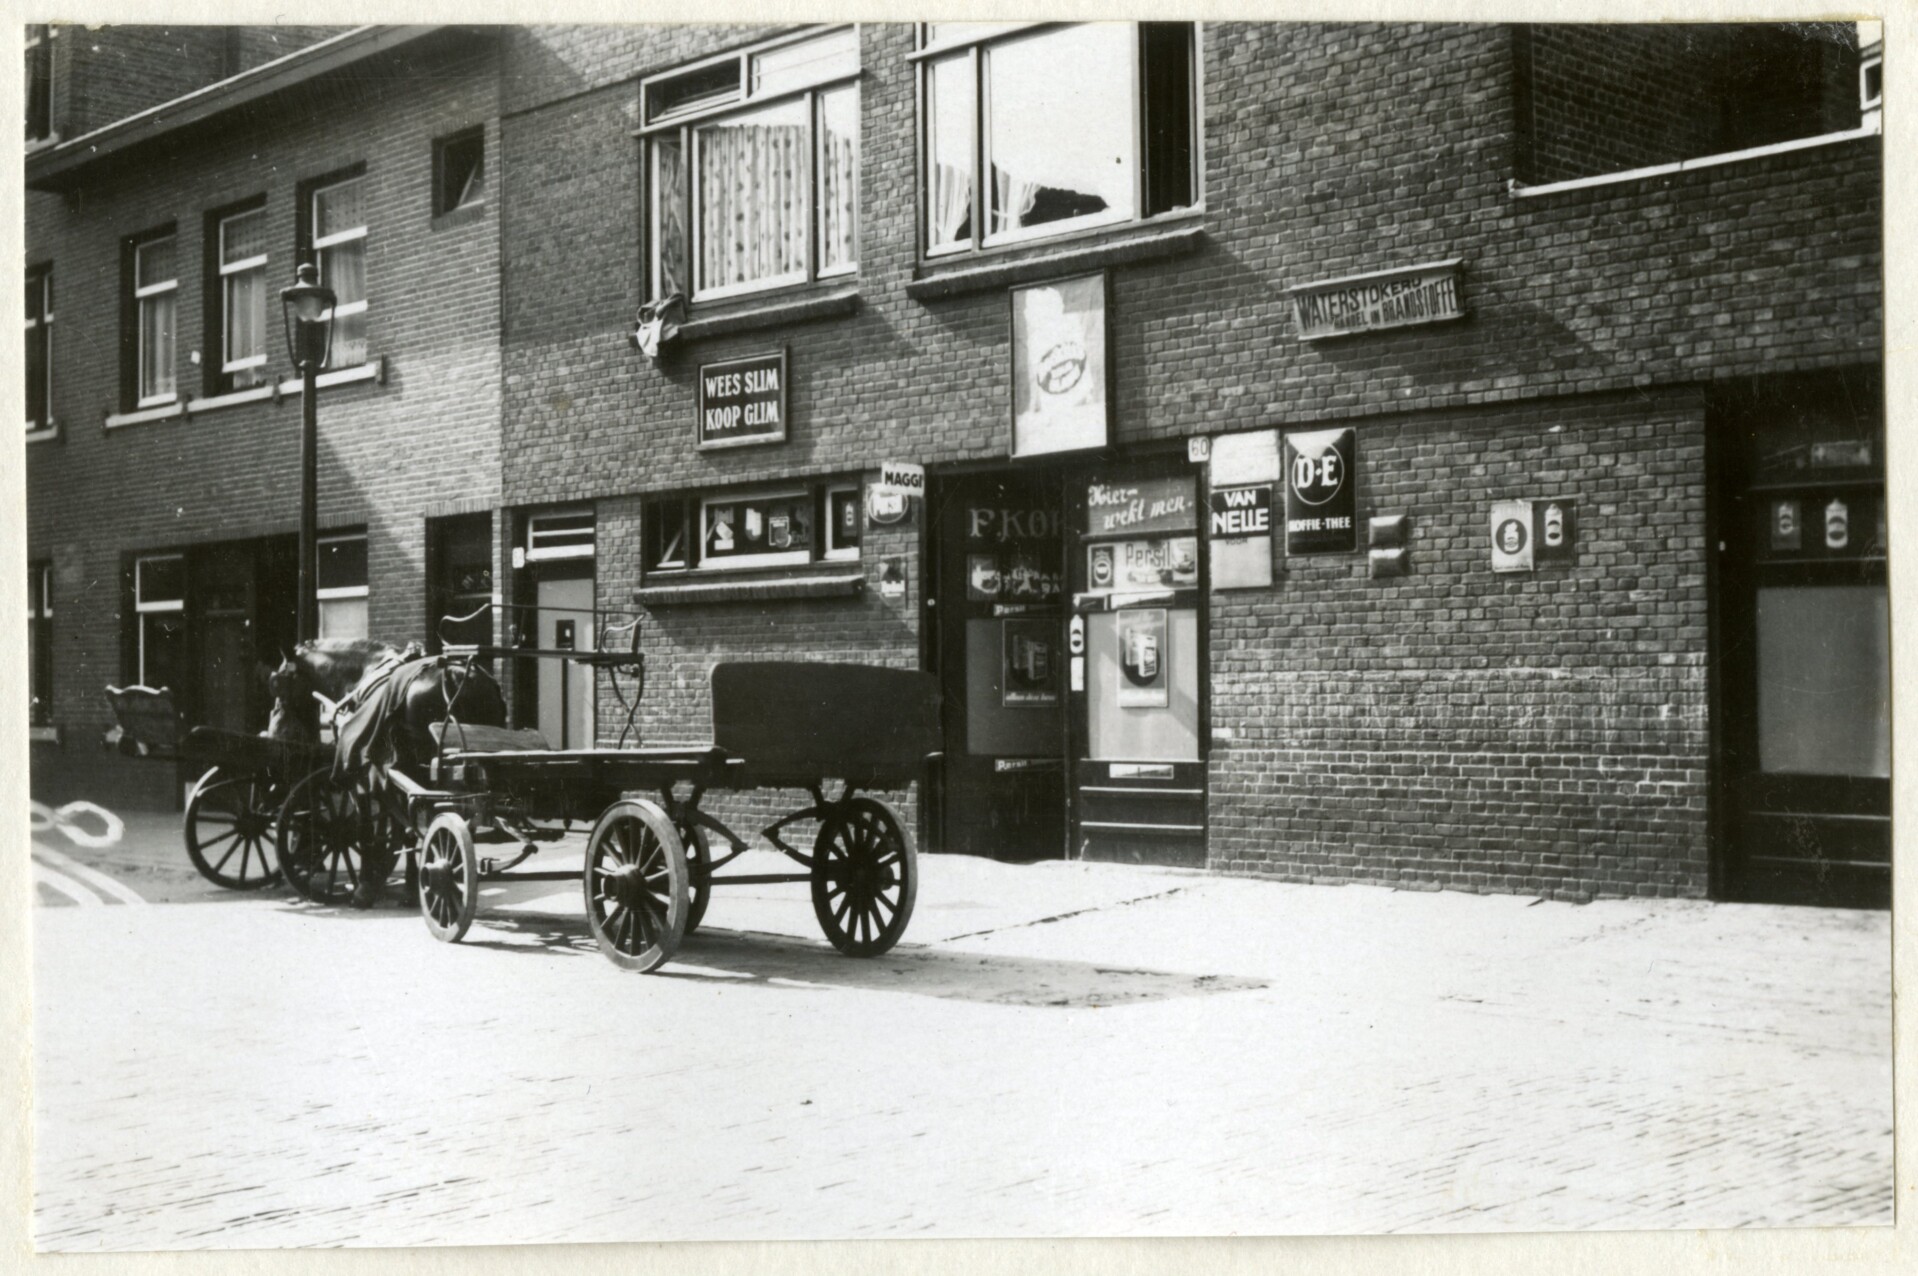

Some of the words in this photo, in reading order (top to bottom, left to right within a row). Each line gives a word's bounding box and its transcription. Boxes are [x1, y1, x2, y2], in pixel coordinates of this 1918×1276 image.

[705, 373, 741, 399] WEES
[744, 368, 779, 394] SLIM
[705, 405, 741, 431] KOOP
[744, 401, 779, 425] GLIM
[1191, 438, 1208, 456] 60
[885, 471, 922, 488] MAGGI
[1224, 490, 1257, 508] VAN
[1211, 508, 1269, 535] NELLE
[1125, 541, 1171, 569] Persil
